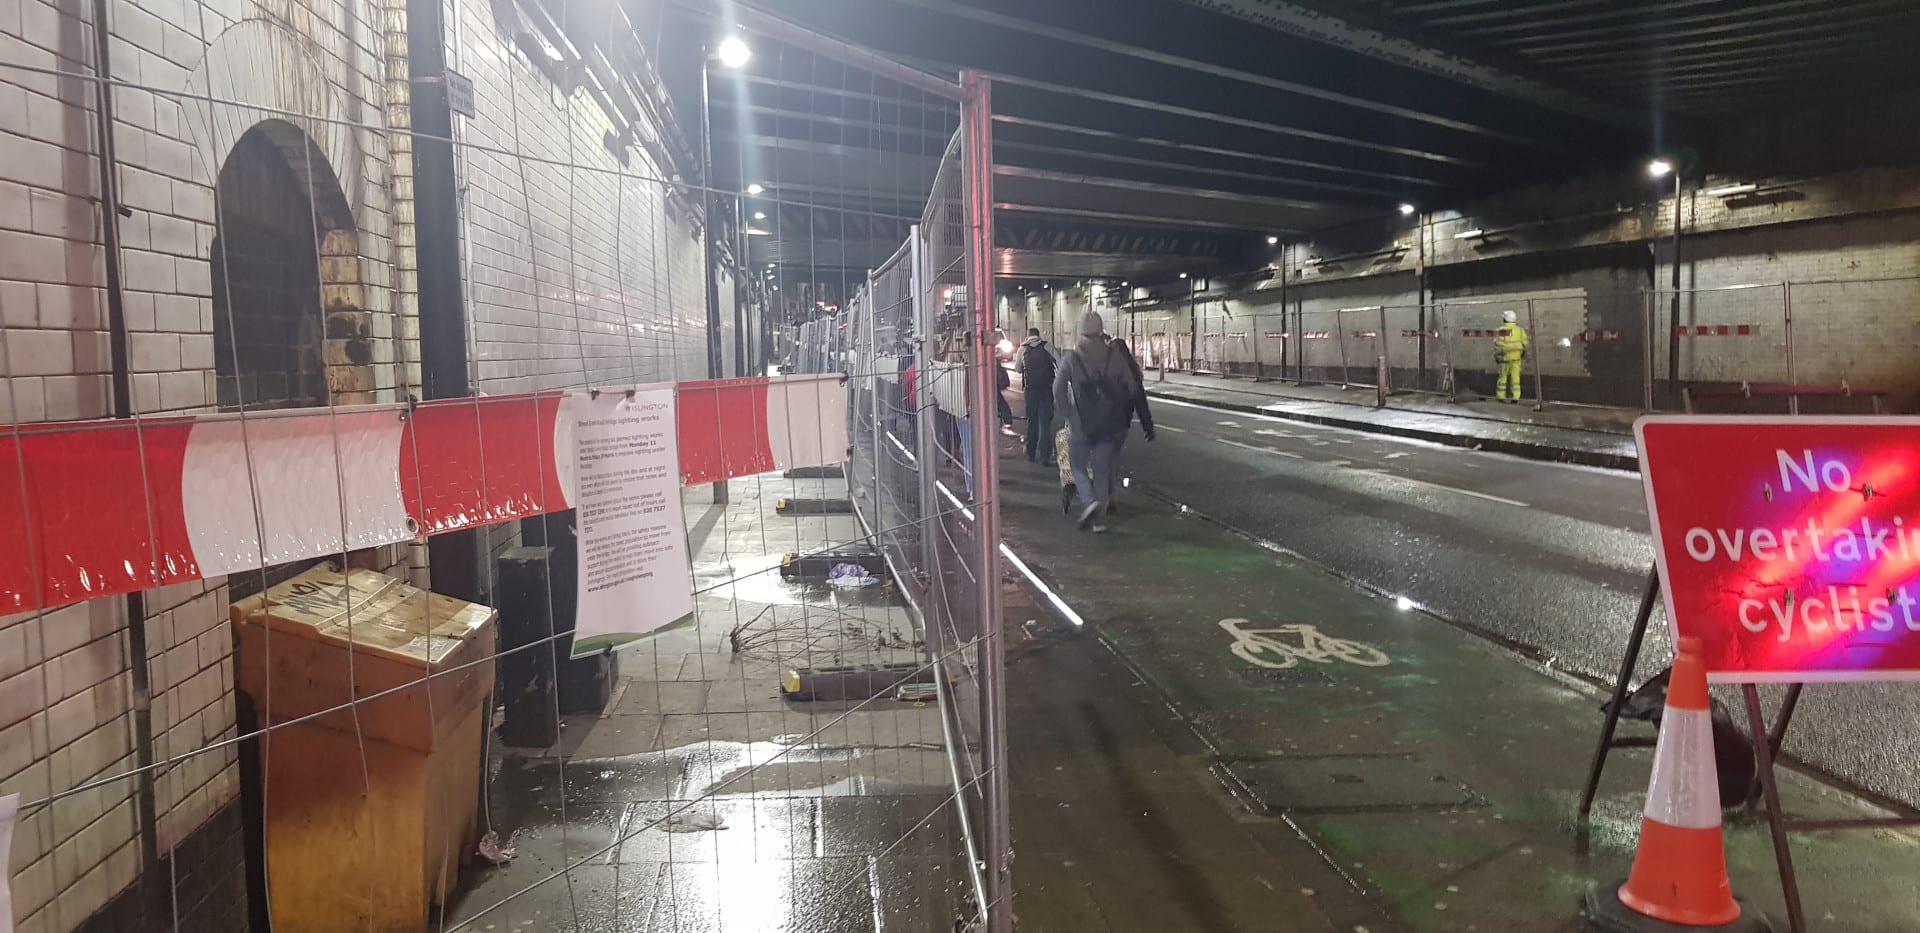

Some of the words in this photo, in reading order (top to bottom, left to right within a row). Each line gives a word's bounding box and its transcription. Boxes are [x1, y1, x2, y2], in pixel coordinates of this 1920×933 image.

[631, 403, 669, 412] ISLINGTON
[1776, 448, 1852, 493] No
[1738, 585, 1920, 643] cyclist
